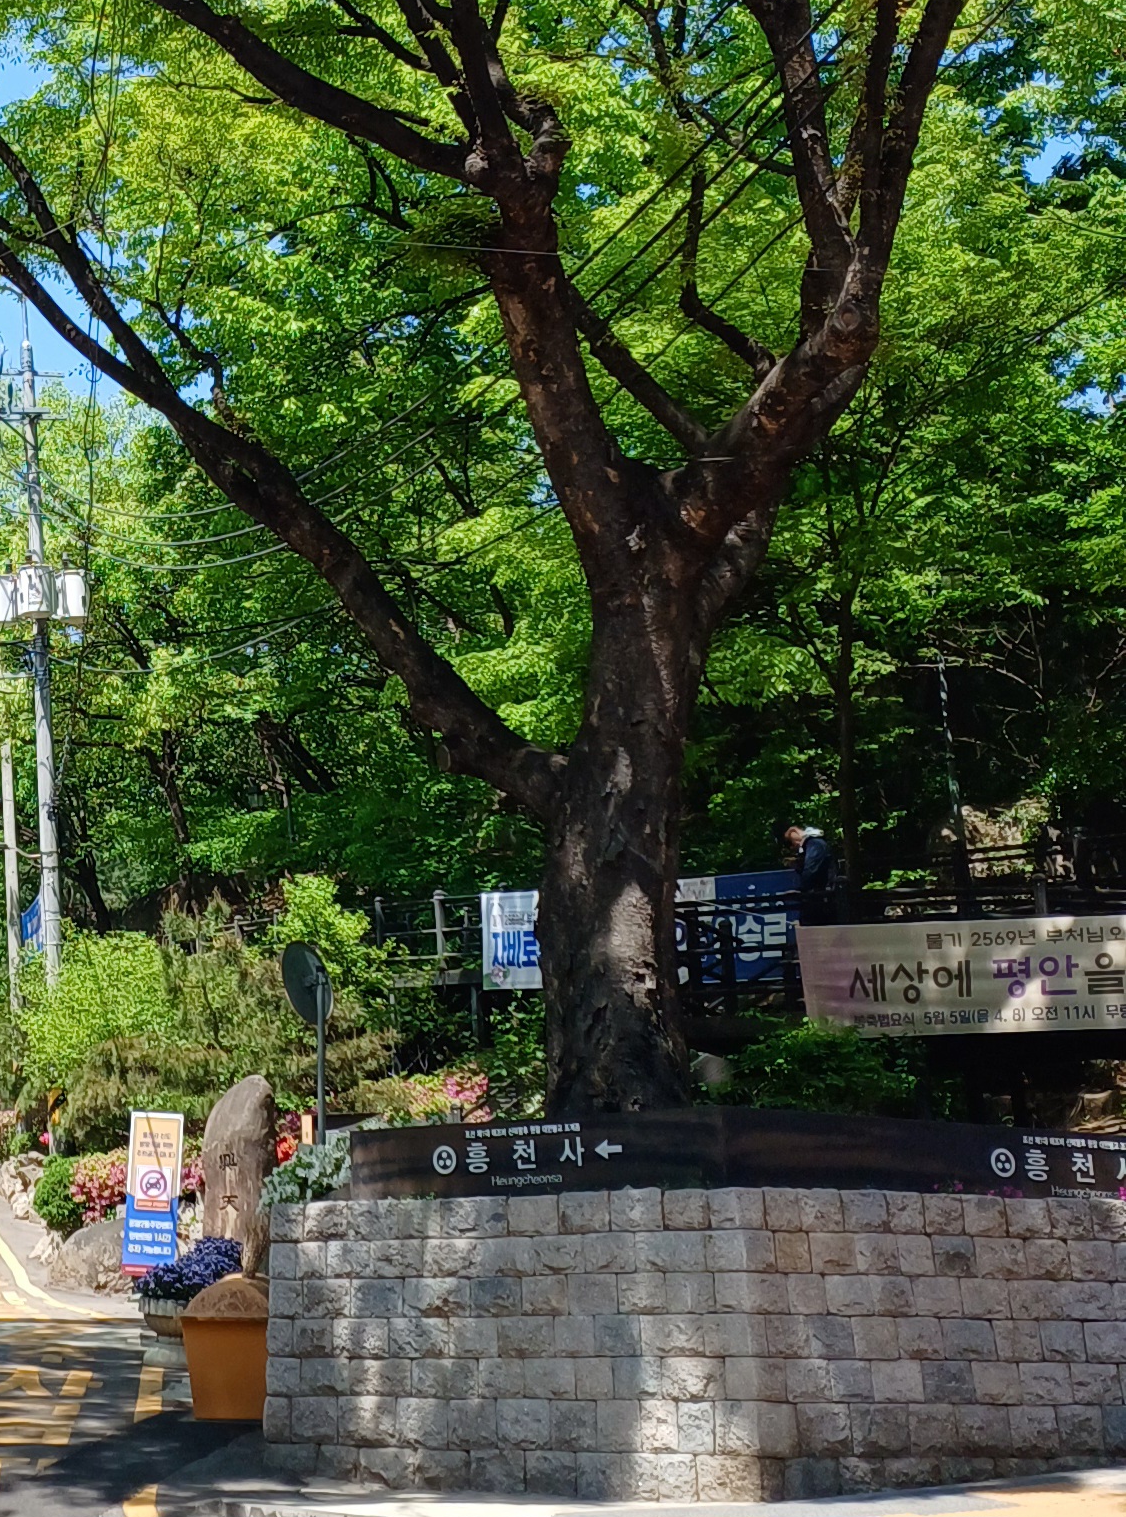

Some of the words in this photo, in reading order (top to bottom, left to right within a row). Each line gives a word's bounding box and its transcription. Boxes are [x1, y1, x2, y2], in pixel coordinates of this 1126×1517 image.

[970, 929, 1036, 947] 2569년
[849, 959, 973, 1005] 세상에
[992, 952, 1126, 999] 평안을
[923, 1010, 946, 1026] 5월
[1031, 1006, 1059, 1021] 오전
[1063, 1004, 1096, 1020] 11시
[465, 1136, 585, 1174] 흥천사
[491, 1173, 563, 1187] Heungcheonsa
[1051, 1185, 1124, 1199] Heungcheons
